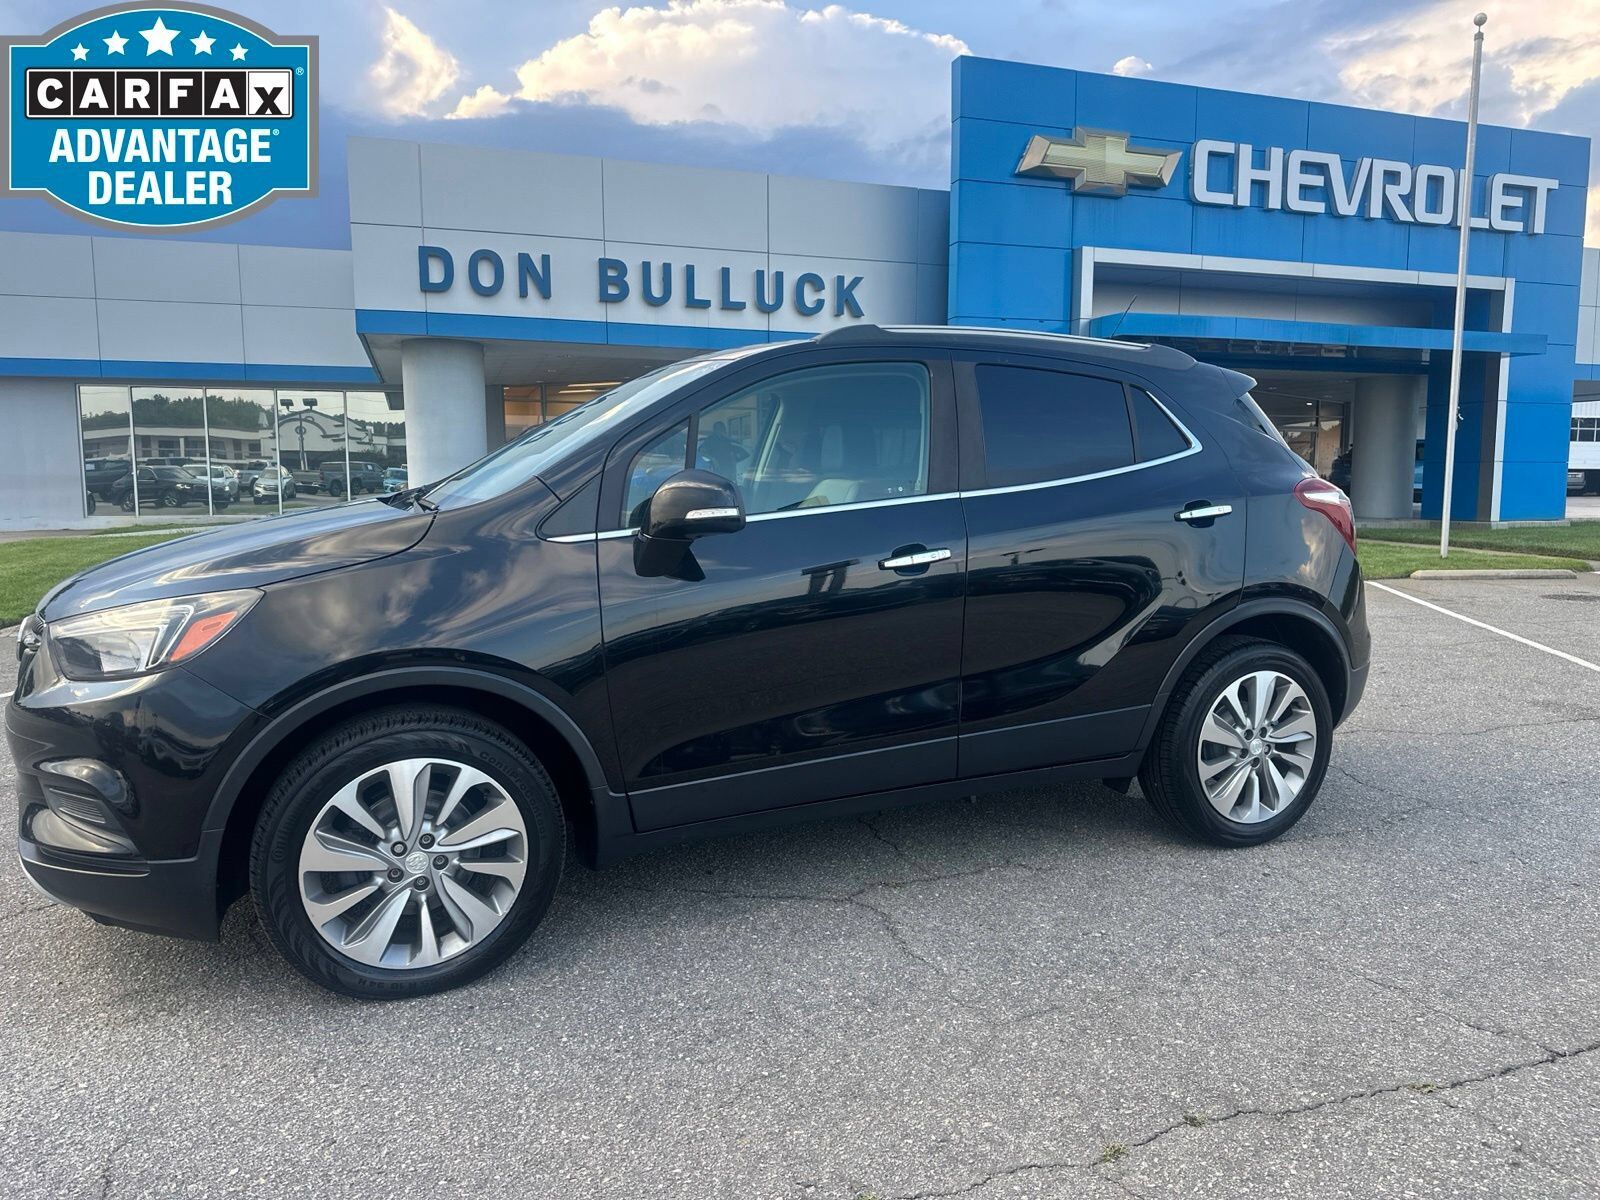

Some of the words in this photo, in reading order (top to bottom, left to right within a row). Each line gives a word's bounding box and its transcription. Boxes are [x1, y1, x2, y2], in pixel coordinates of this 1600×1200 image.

[1191, 138, 1559, 235] CHEVROLET
[418, 245, 551, 299] DON
[598, 257, 865, 318] BULLUCK
